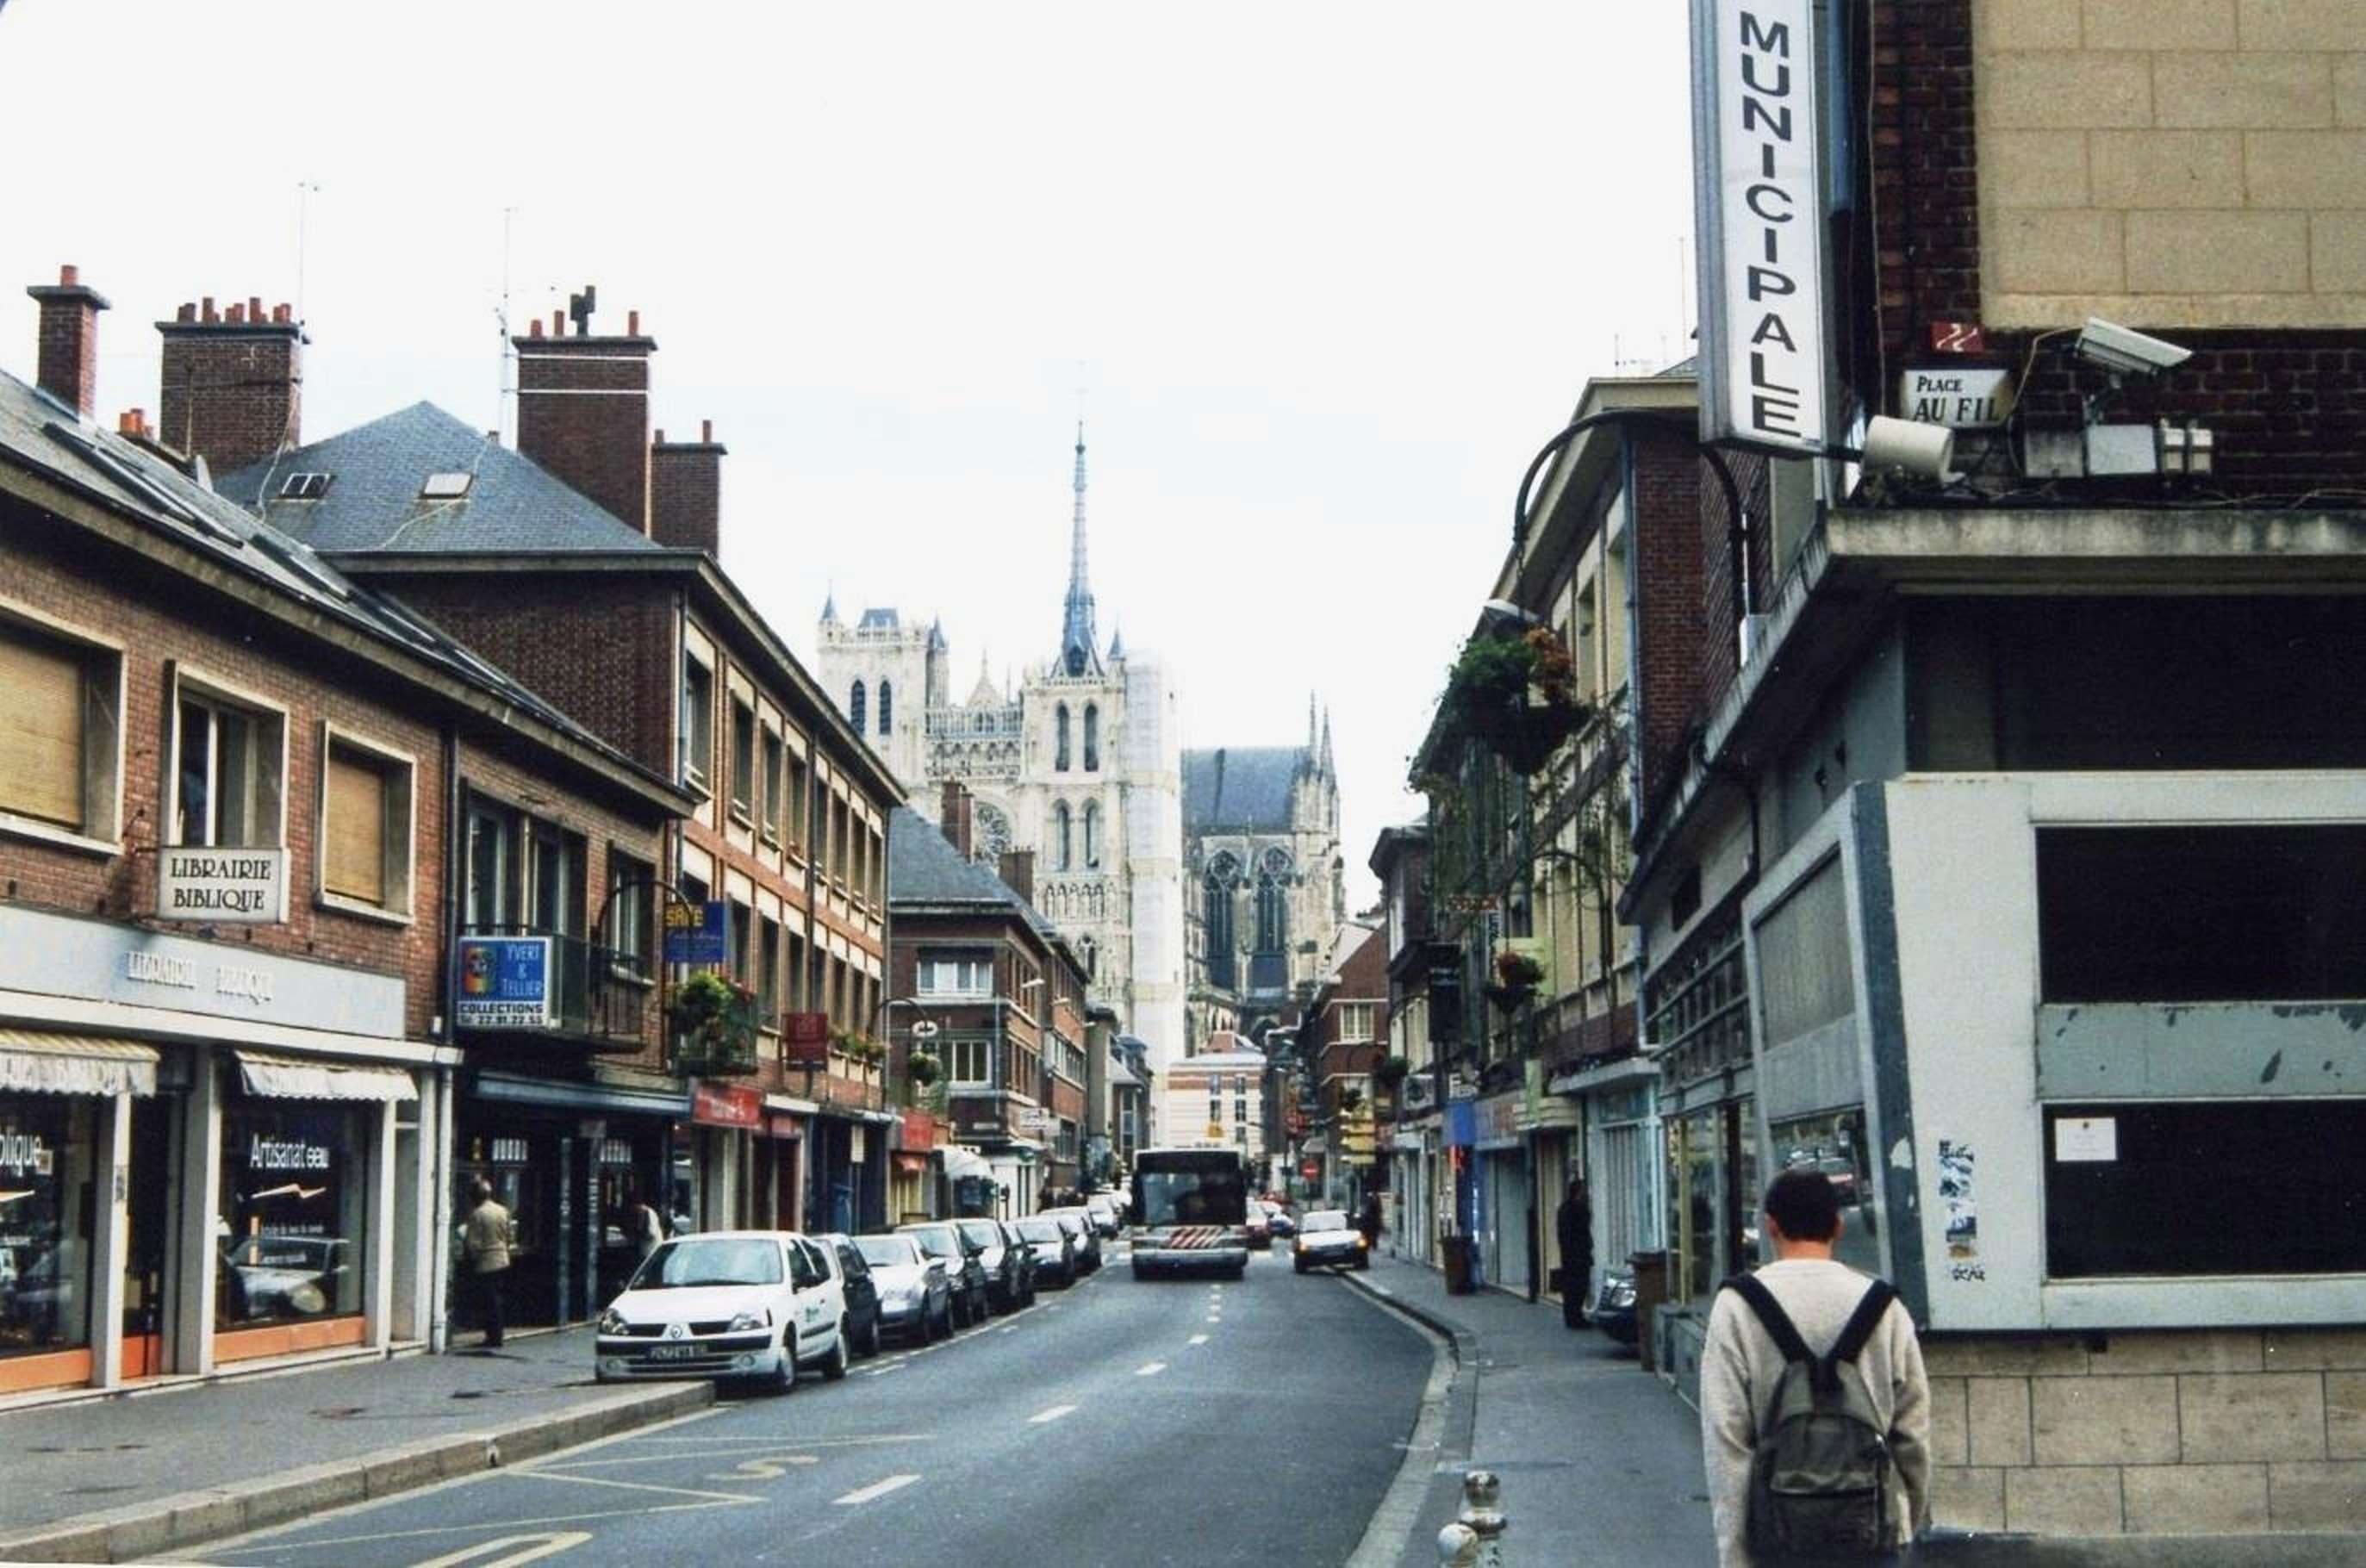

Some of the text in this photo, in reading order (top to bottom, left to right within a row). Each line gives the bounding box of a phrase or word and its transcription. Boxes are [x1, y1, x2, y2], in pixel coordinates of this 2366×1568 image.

[1739, 10, 1803, 439] MUNICIPALE
[1916, 375, 1964, 392] PLACE
[1913, 397, 2000, 422] AU FIL
[170, 857, 272, 880] LIBRAIRIE
[174, 888, 265, 912] BIBLIQUE
[461, 1004, 544, 1014] COLLECTIONS
